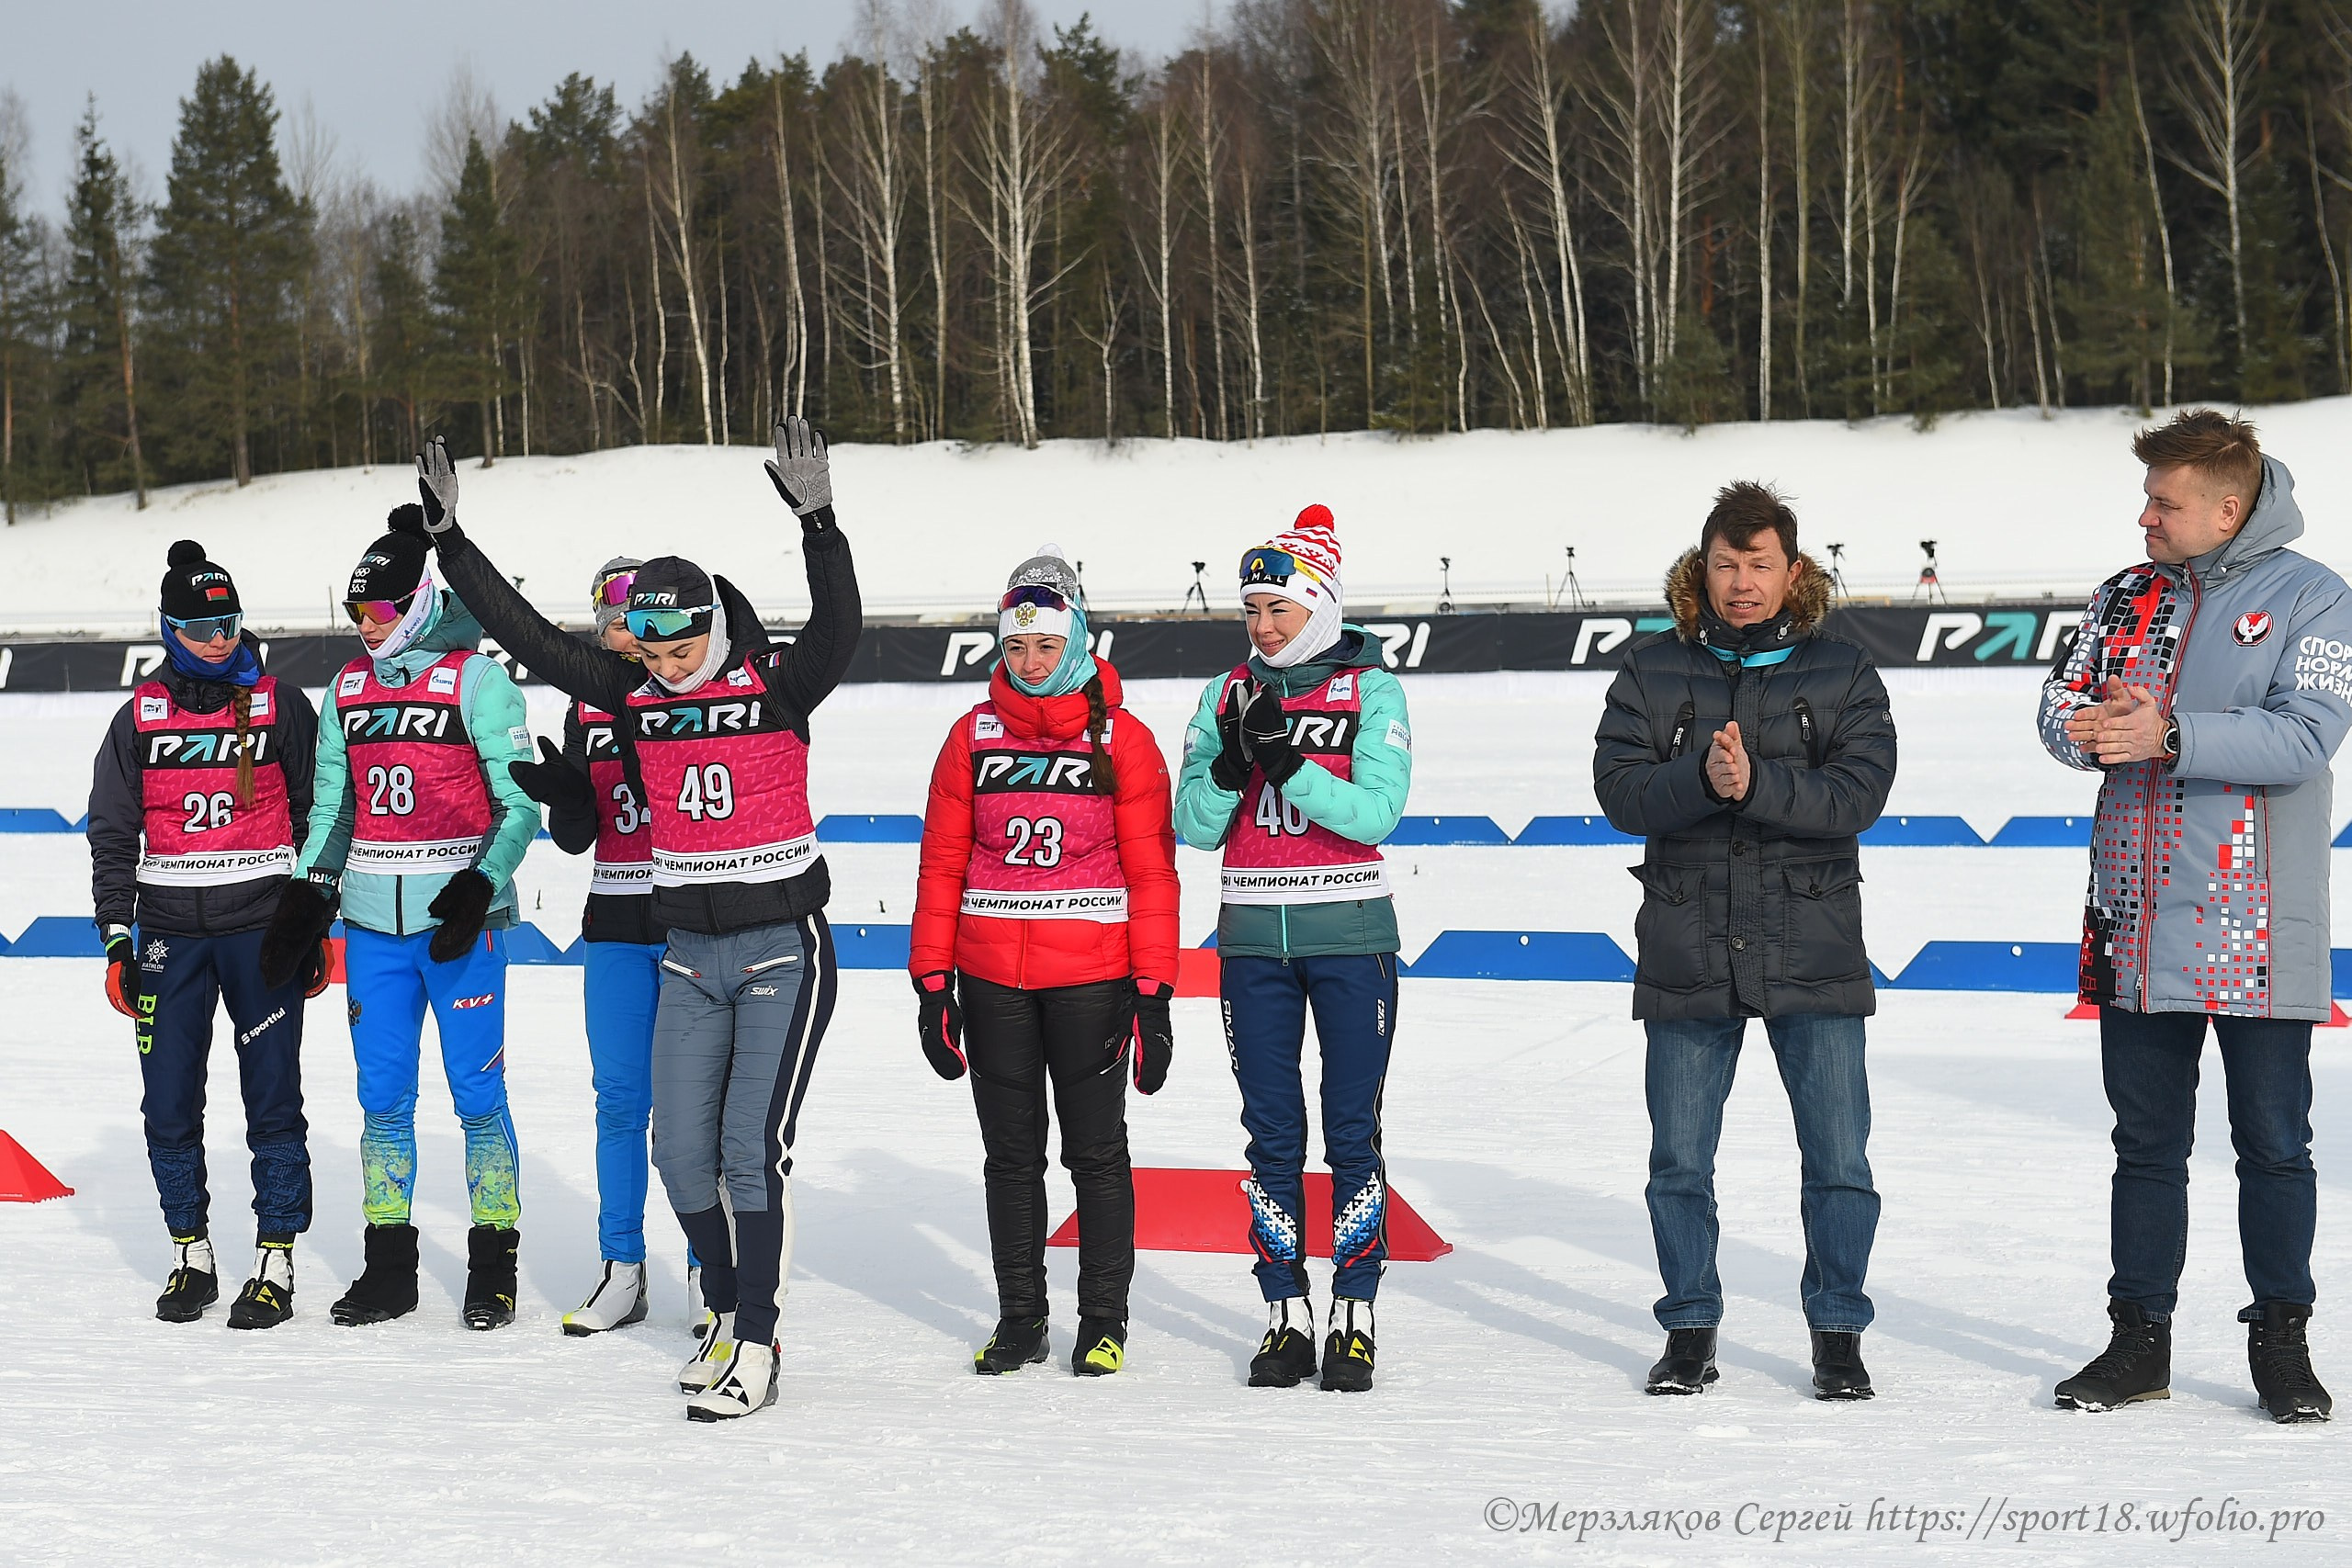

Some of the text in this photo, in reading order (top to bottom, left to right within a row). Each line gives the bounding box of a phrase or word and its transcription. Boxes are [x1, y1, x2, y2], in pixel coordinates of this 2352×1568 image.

[191, 572, 229, 587] PARI
[349, 584, 366, 593] 365
[634, 592, 676, 606] PARI
[2294, 672, 2352, 707] ЖИЗН
[344, 706, 449, 739] PARI
[640, 701, 762, 735] PARI
[1286, 716, 1349, 747] RI
[149, 731, 267, 763] PARI
[977, 756, 1093, 788] PAR
[368, 764, 416, 816] 28
[677, 762, 735, 821] 49
[184, 791, 234, 832] 26
[354, 848, 424, 859] ЧЕМПИОНАТ
[1003, 816, 1064, 867] 23
[664, 856, 749, 873] ЧЕМПИОНАТ
[752, 843, 810, 866] РОССИИ
[600, 869, 652, 880] ЧЕМПИОН
[1233, 874, 1320, 887] ЧЕМПИОНАТ
[1323, 870, 1379, 885] РОССИИ
[971, 898, 1064, 910] ЧЕМПИОНАТ
[1068, 896, 1123, 908] РОССИИ
[452, 993, 495, 1010] KV+
[249, 1007, 287, 1039] sportful
